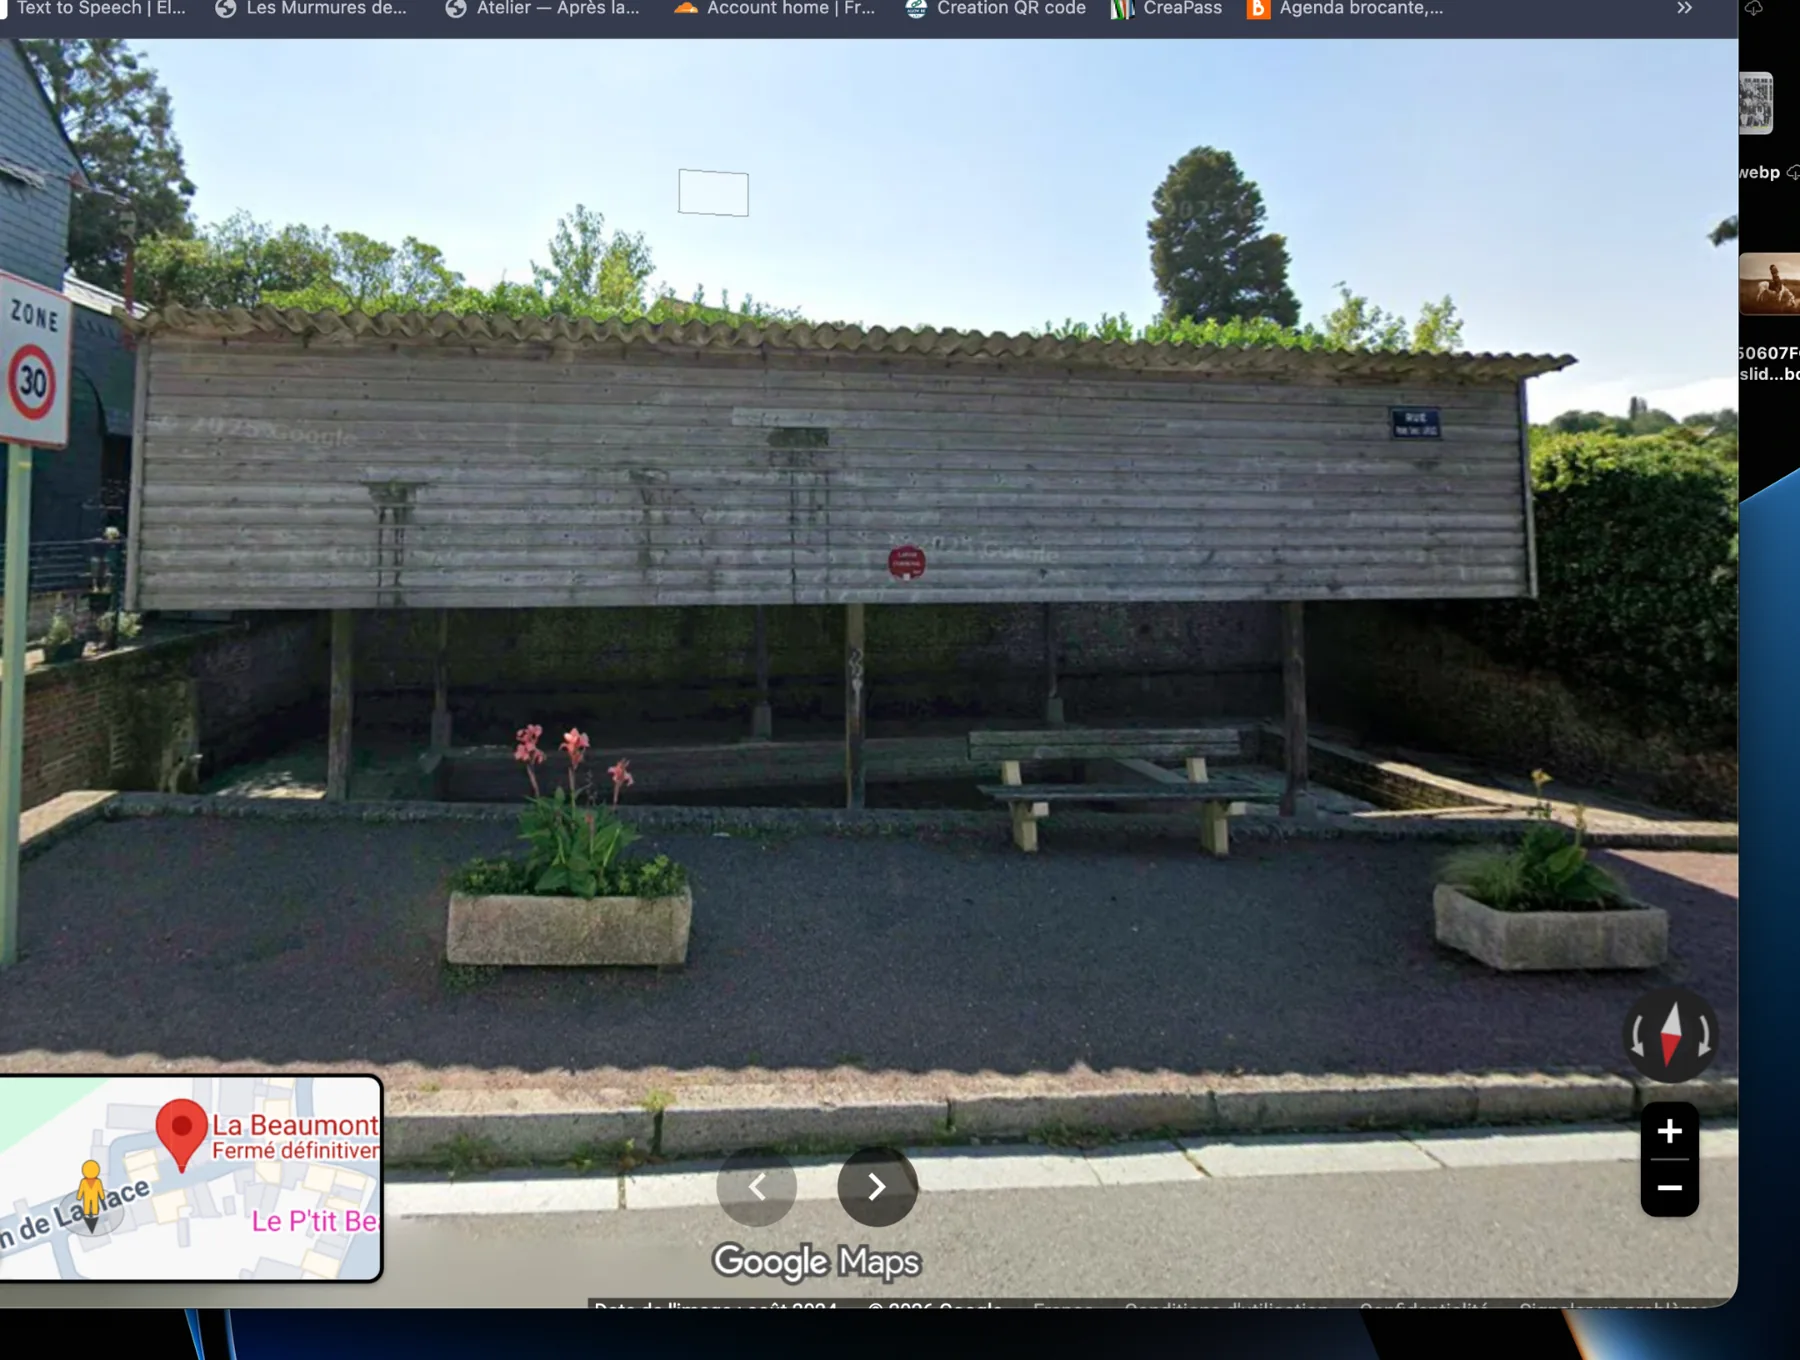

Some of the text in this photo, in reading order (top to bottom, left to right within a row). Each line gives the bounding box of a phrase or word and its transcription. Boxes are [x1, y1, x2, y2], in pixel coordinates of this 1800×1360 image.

[16, 0, 52, 15] Text
[56, 0, 74, 15] to
[78, 0, 142, 17] Speech
[247, 0, 276, 15] Les
[282, 0, 366, 15] Murmures
[476, 0, 532, 15] Atelier
[557, 0, 606, 17] Après
[707, 0, 778, 15] Account
[782, 0, 829, 15] home
[937, 0, 1009, 15] Creation
[1014, 0, 1039, 16] QR
[1044, 0, 1086, 15] code
[1143, 0, 1223, 15] CreaPass
[1280, 0, 1344, 17] Agenda
[10, 297, 58, 334] ZONE
[20, 364, 47, 399] 30
[213, 1114, 379, 1136] La Beaumont
[213, 1141, 275, 1159] Fermé
[20, 1216, 51, 1240] de
[53, 1204, 86, 1227] La
[84, 1180, 150, 1219] lace
[253, 1209, 380, 1232] Le P'tit Be
[714, 1243, 921, 1283] Google Maps
